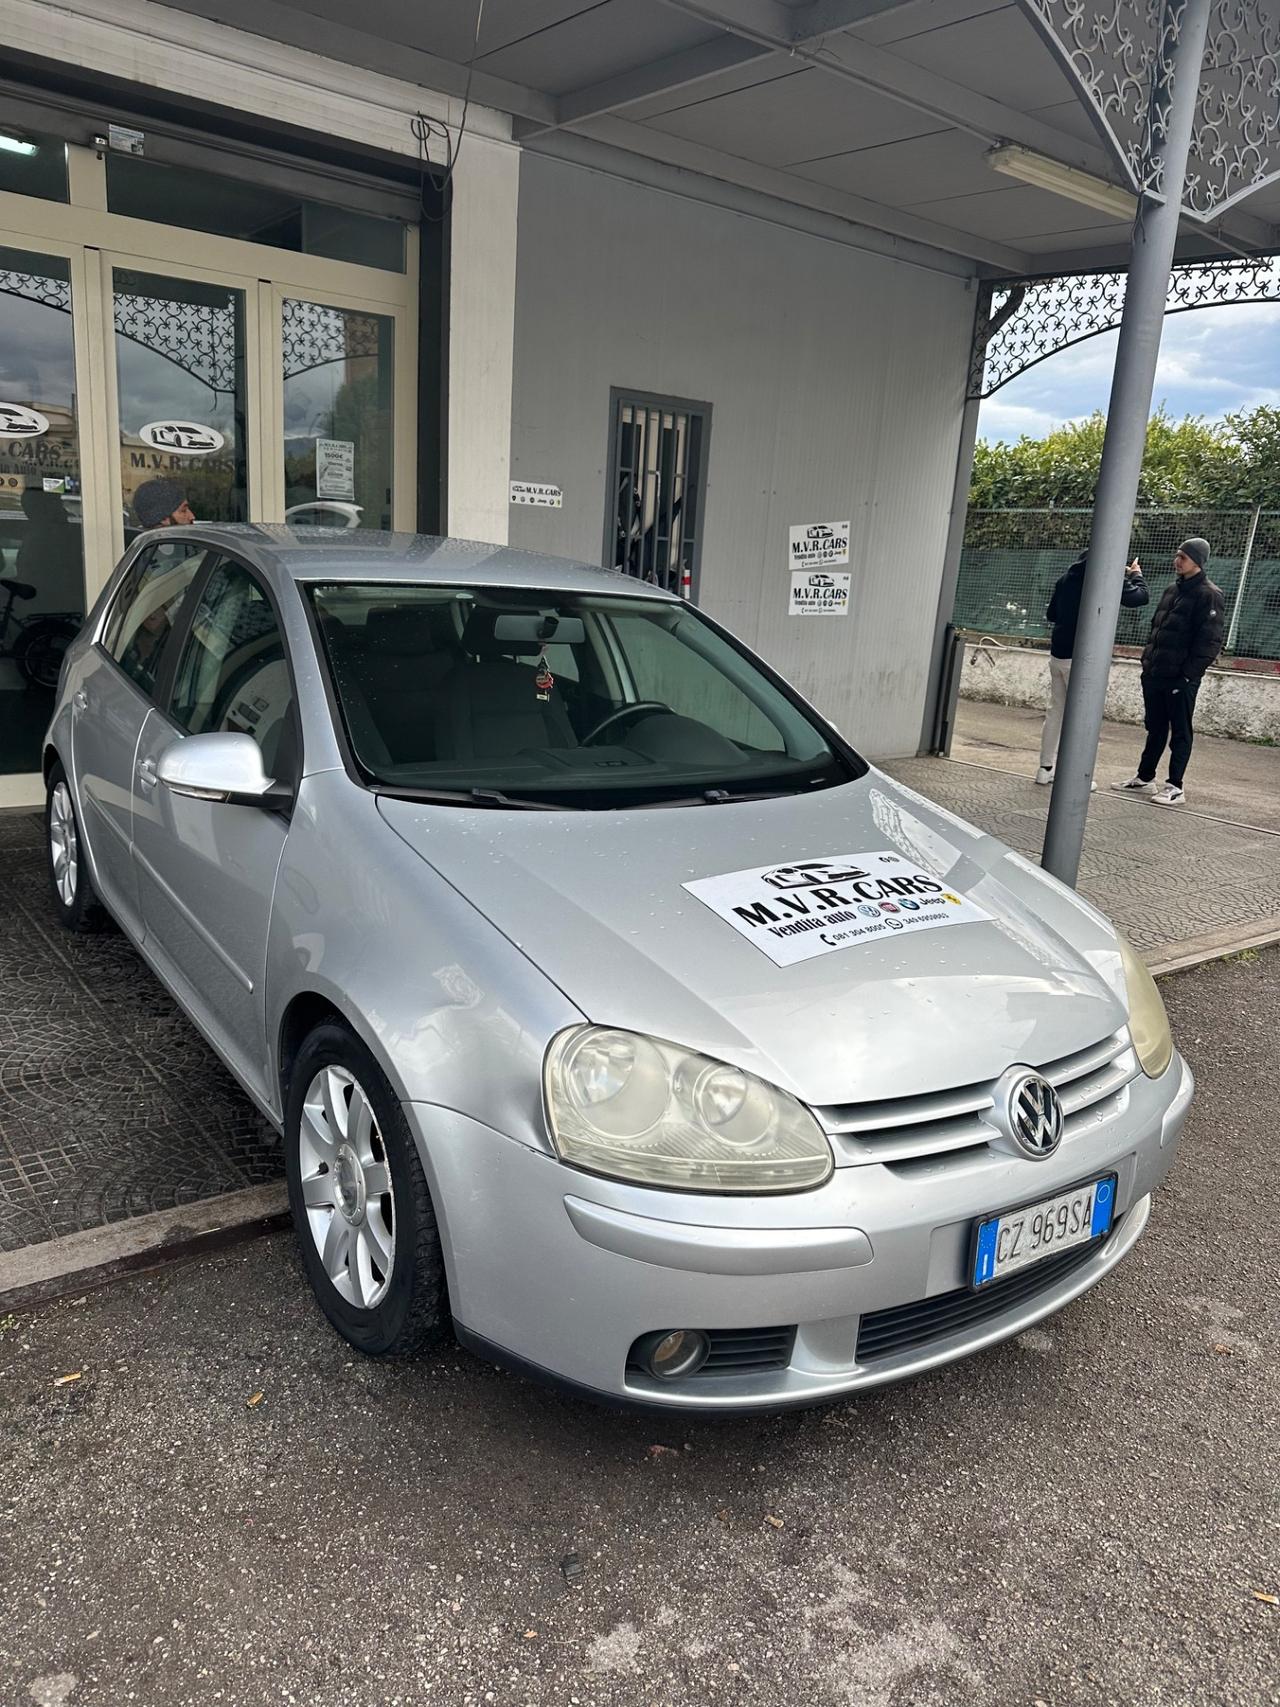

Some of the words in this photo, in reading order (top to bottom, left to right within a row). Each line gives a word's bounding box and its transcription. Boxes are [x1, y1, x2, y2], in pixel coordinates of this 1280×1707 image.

[792, 537, 848, 553] M.V.R.CARS
[793, 588, 848, 599] M.V.R.CARS
[732, 874, 943, 928] M.V.R.CARS
[767, 918, 827, 938] Vendita
[823, 911, 857, 924] auto
[833, 930, 850, 941] 081
[849, 927, 866, 937] 304
[996, 1220, 1024, 1264] CZ
[1031, 1196, 1092, 1249] 969SA
